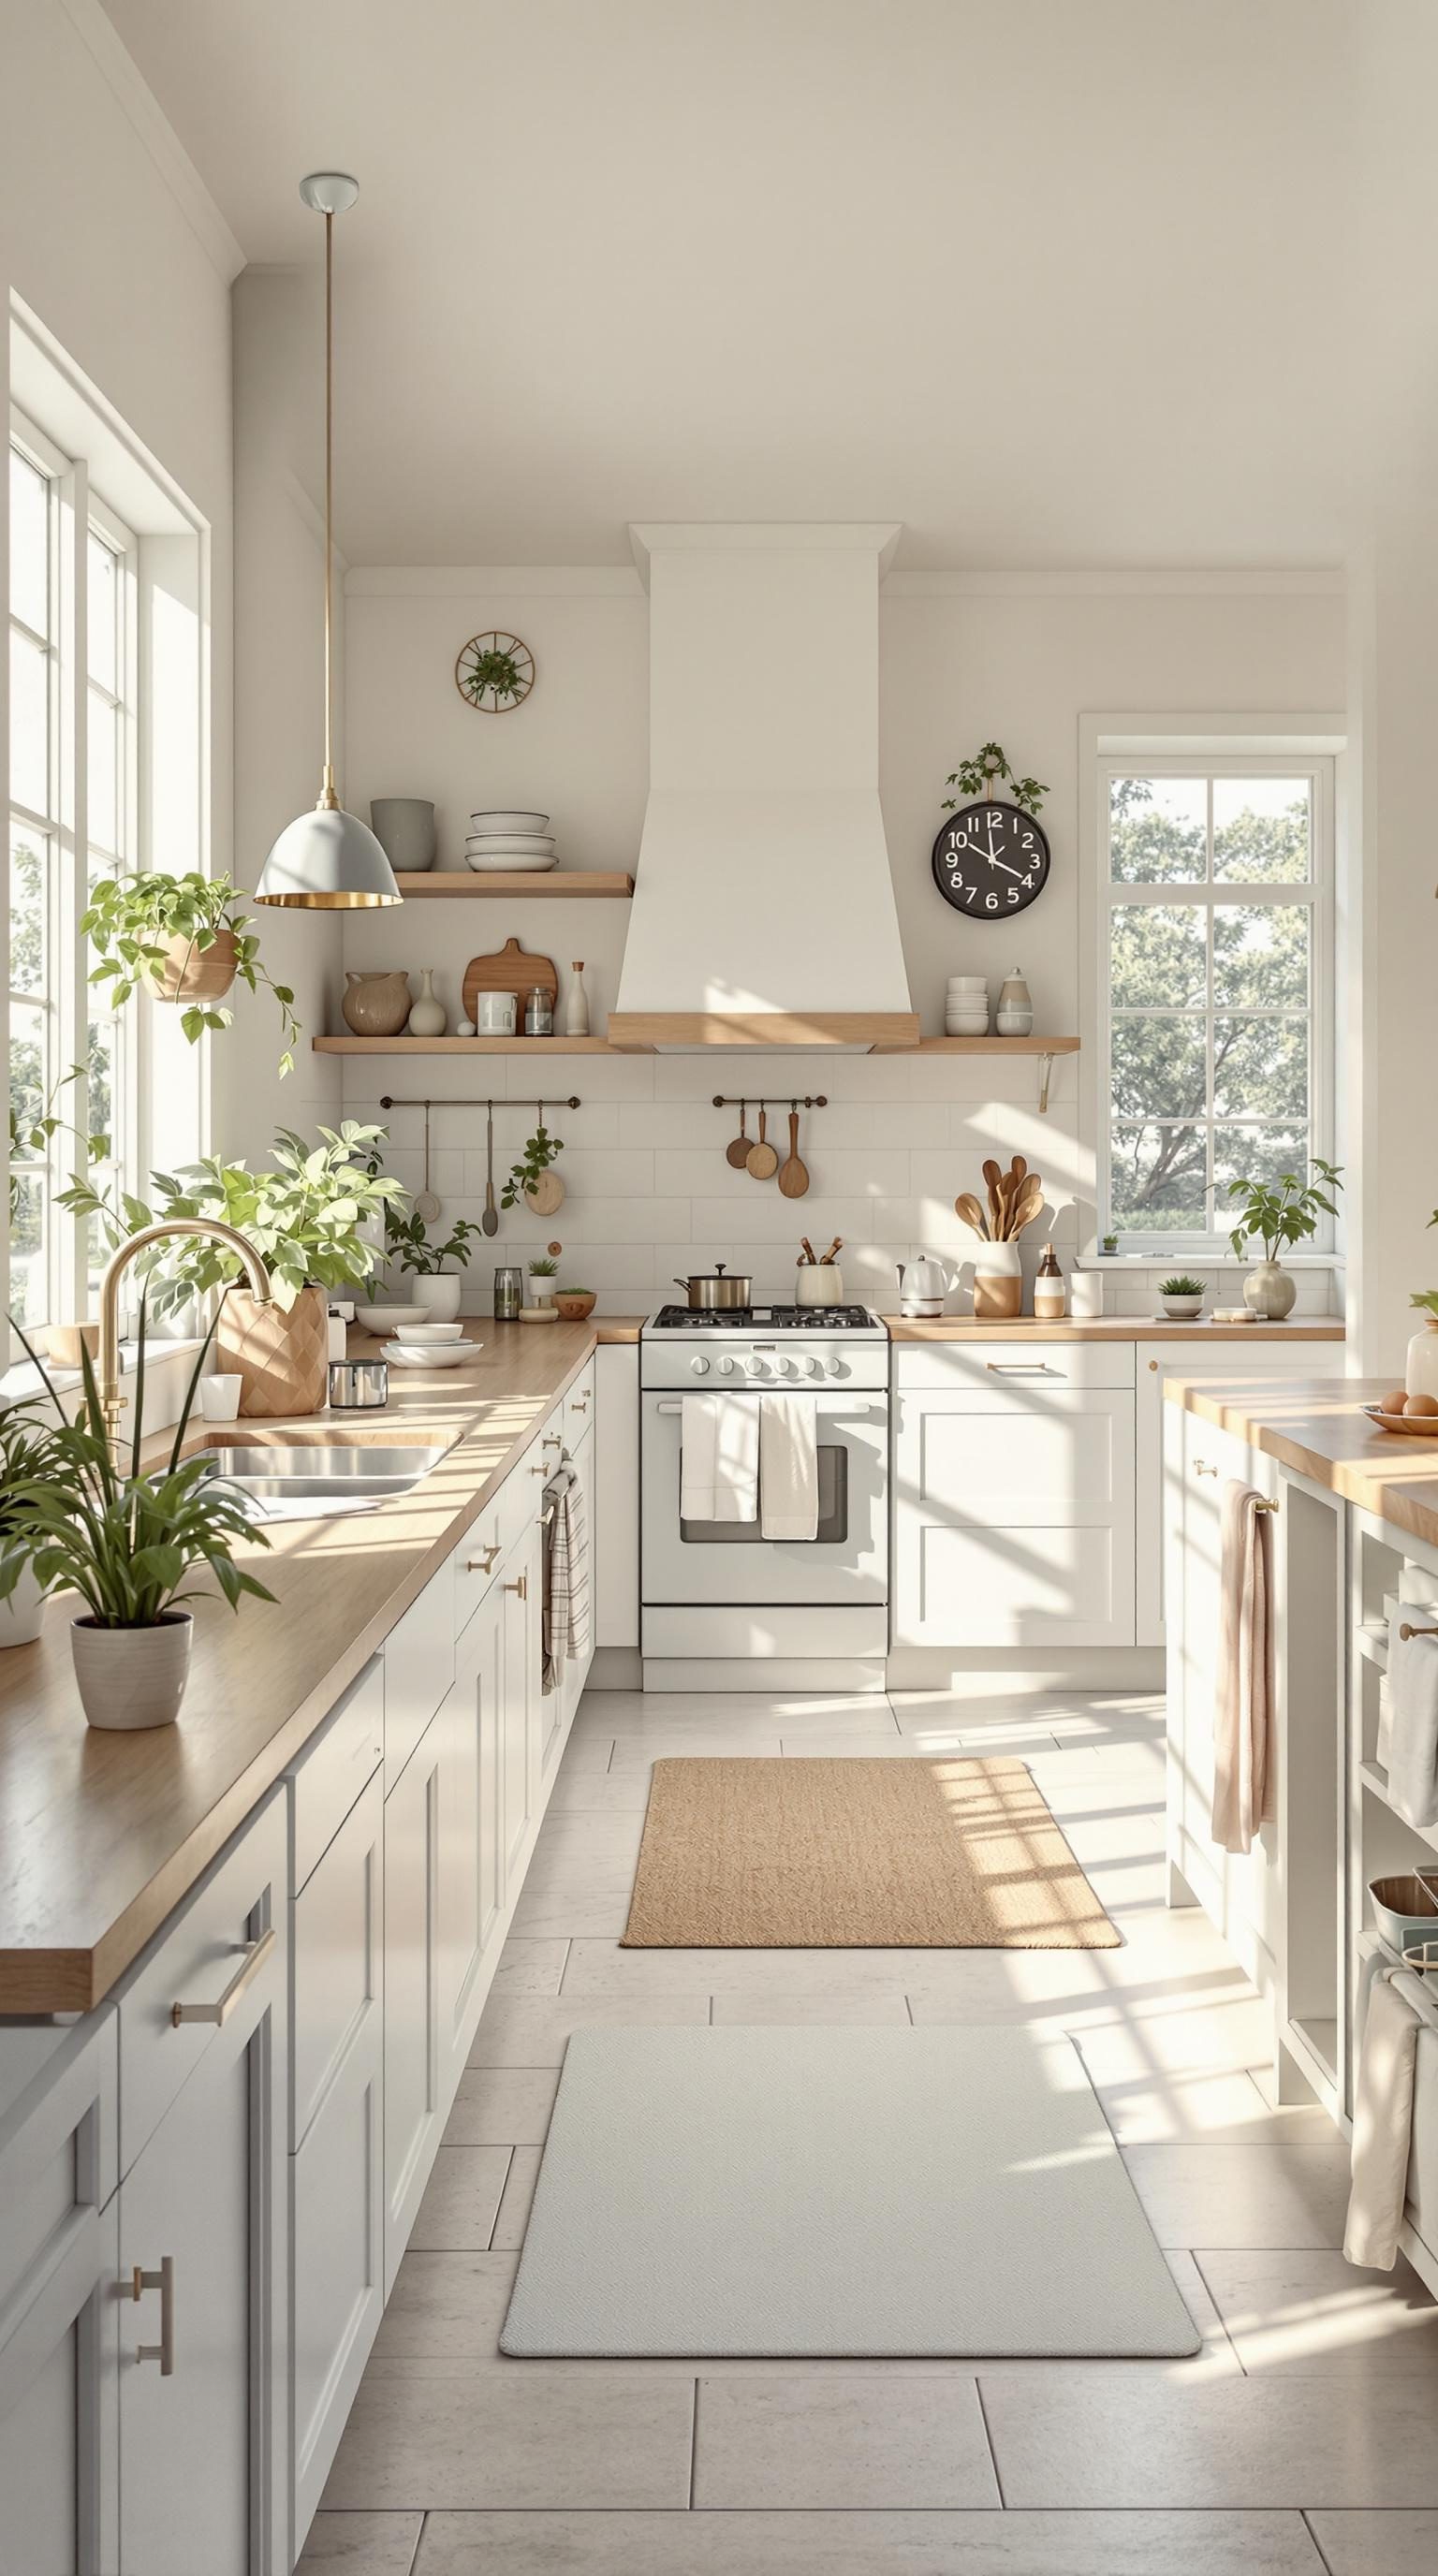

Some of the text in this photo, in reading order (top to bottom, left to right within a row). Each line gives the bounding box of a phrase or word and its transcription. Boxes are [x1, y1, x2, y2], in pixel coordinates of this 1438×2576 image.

[967, 817, 979, 832] 11
[986, 812, 1004, 828] 12
[1013, 817, 1018, 834] 1
[947, 831, 968, 849] 10
[1021, 832, 1034, 849] 2
[946, 852, 959, 869] 9
[1029, 854, 1041, 869] 3
[950, 871, 963, 888] 8
[1020, 873, 1035, 889] 4
[965, 886, 978, 904] 7
[985, 892, 999, 909] 6
[1006, 887, 1020, 903] 5
